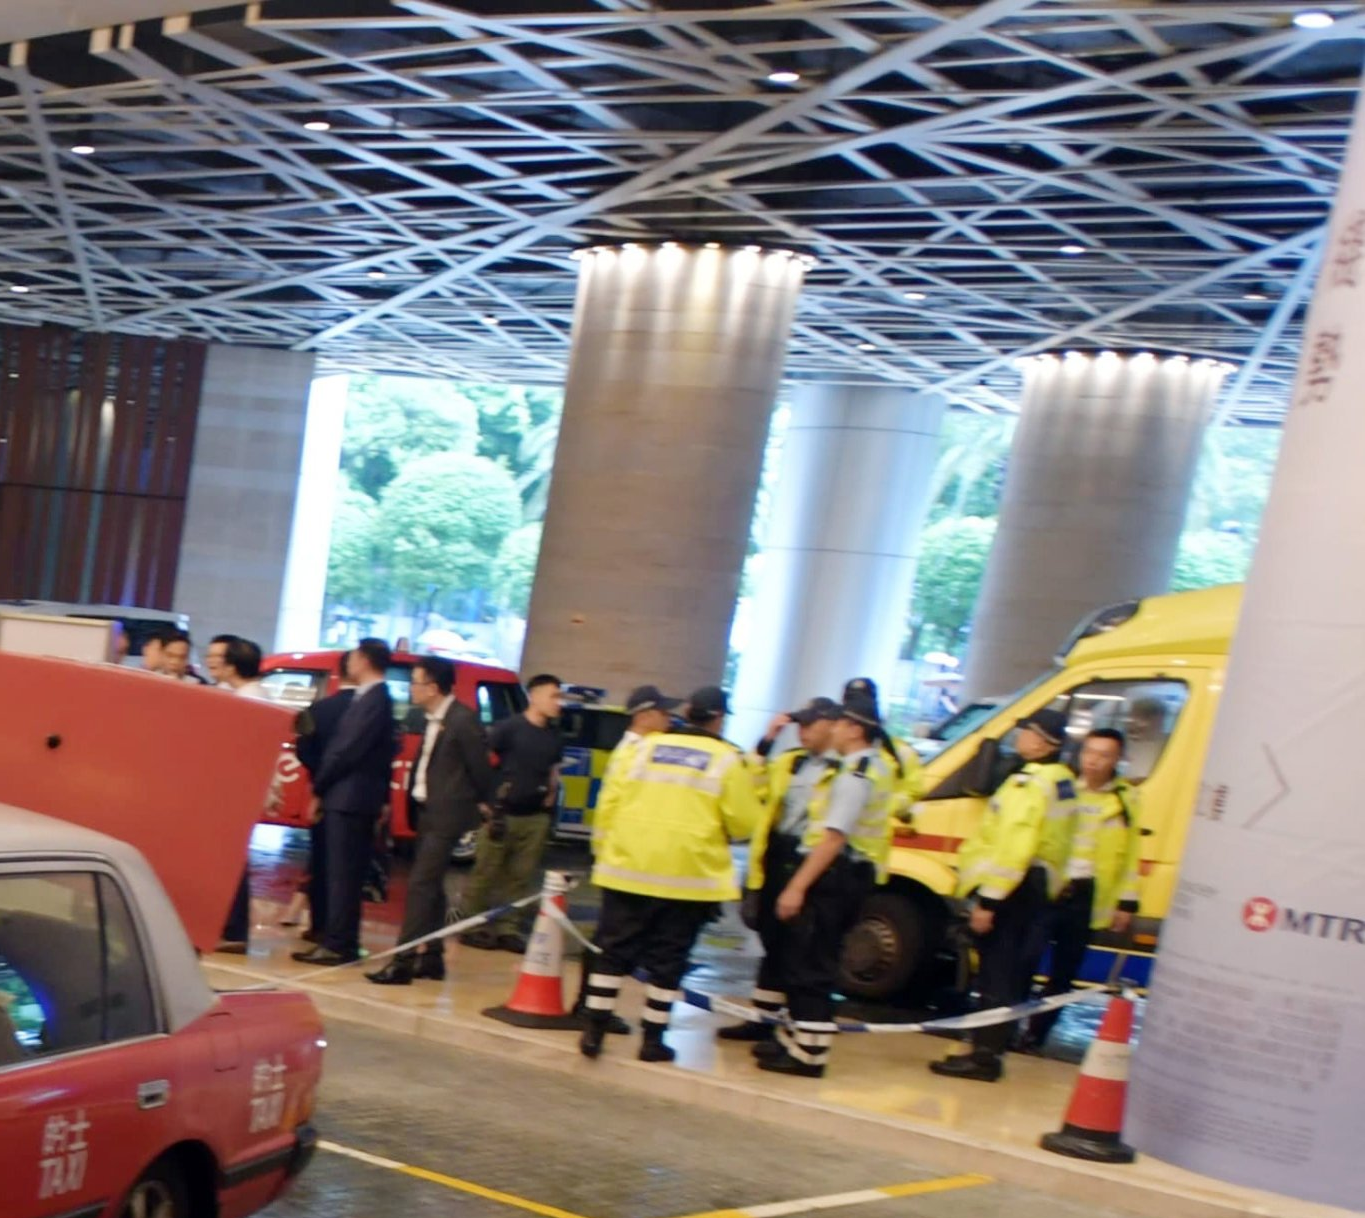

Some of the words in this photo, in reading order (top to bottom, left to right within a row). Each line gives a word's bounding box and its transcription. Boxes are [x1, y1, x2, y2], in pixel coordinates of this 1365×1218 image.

[1282, 908, 1365, 944] MTR
[42, 1109, 91, 1154] 的士
[249, 1091, 285, 1133] TAXI
[38, 1151, 88, 1200] TAXI
